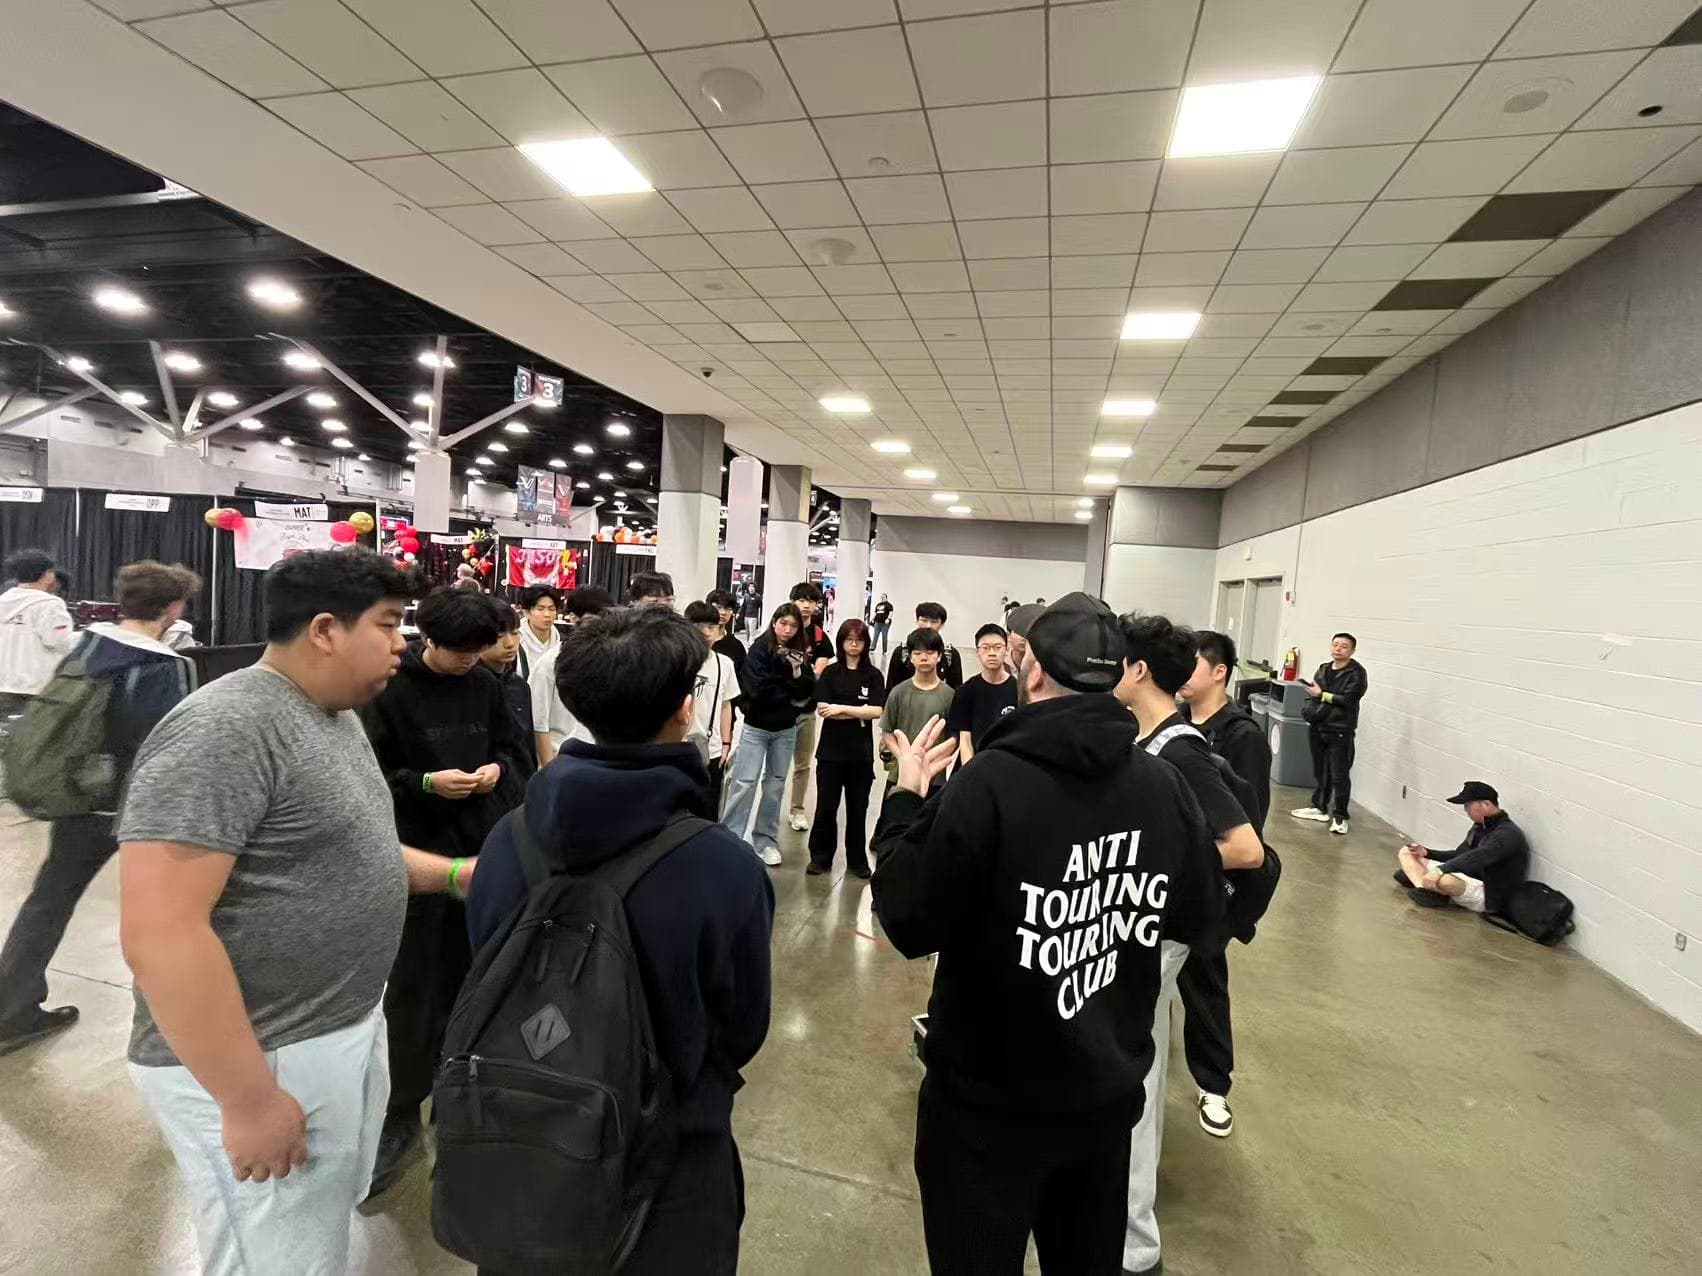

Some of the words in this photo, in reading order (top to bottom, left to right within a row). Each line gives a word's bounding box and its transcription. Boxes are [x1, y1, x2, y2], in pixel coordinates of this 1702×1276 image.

[542, 382, 554, 399] 3
[293, 506, 311, 518] MAT
[537, 513, 553, 523] ARTS
[1062, 829, 1142, 883] ANTI
[1019, 872, 1169, 929] TOURING
[1015, 910, 1161, 976] TOURING
[1057, 949, 1118, 1020] CLUB
